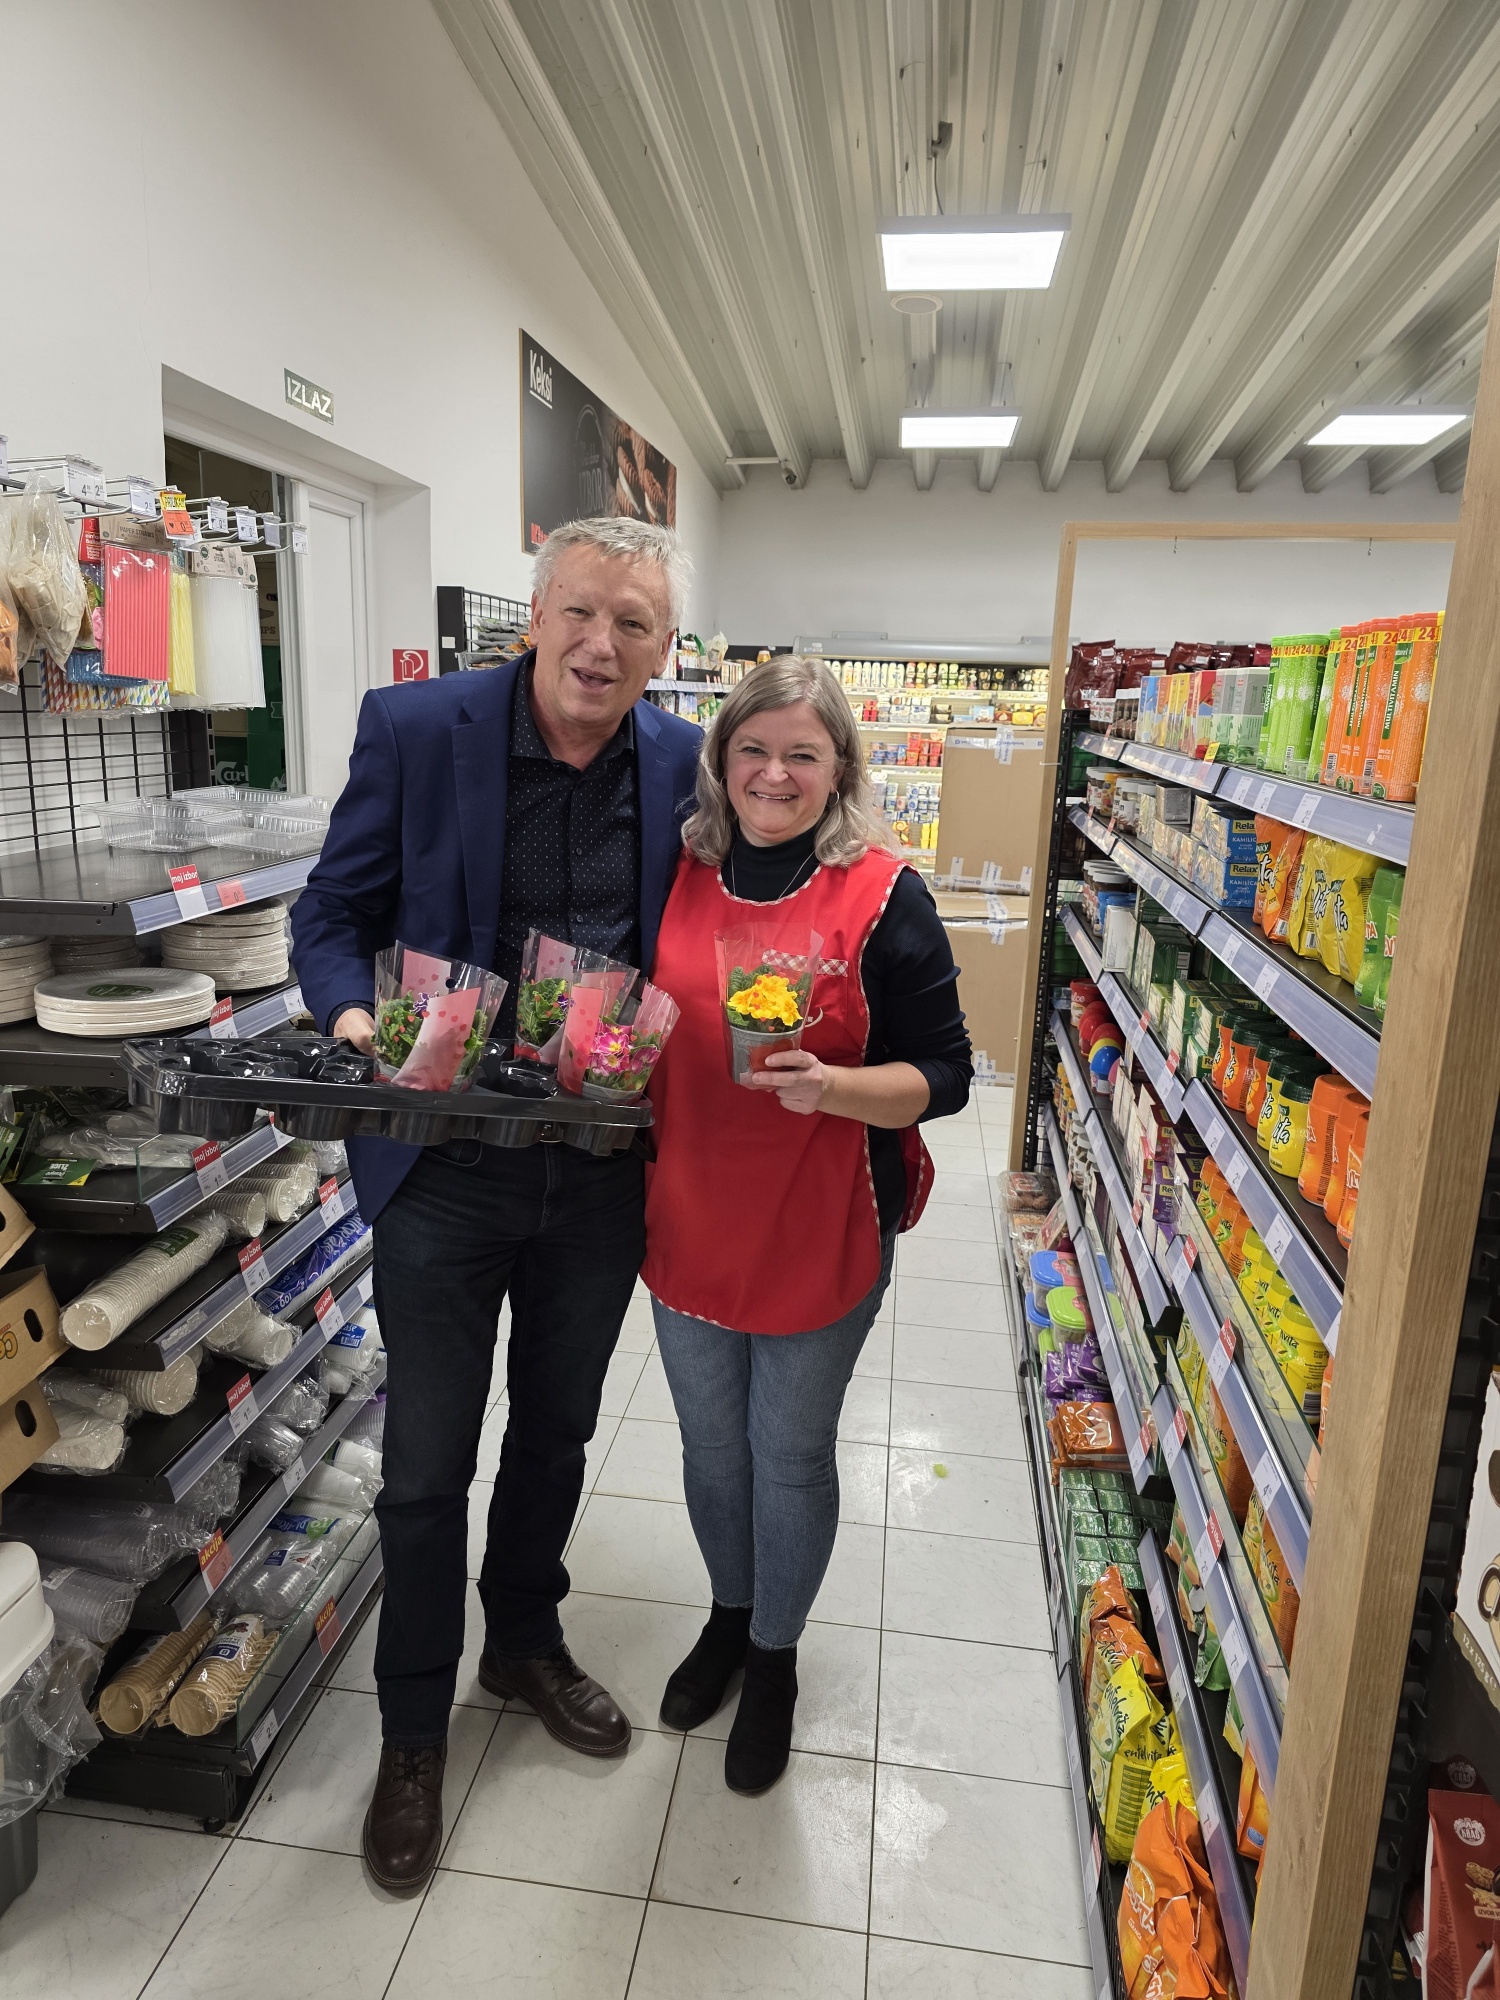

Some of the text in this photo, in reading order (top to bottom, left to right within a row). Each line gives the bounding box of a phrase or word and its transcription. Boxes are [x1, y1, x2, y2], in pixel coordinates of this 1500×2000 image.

[529, 349, 552, 402] Keksi
[287, 376, 332, 418] IZLAZ
[260, 626, 276, 634] IPS
[1383, 632, 1399, 645] 24
[1418, 627, 1436, 640] 24
[1344, 639, 1358, 651] 24
[1385, 670, 1399, 730] MULTIVITAMIN
[215, 761, 249, 785] Carl
[1235, 822, 1255, 830] Rela
[172, 871, 198, 884] moj izbor
[1232, 864, 1258, 873] Relax
[1260, 855, 1278, 888] ta
[1334, 894, 1348, 932] ta
[1365, 920, 1378, 940] TA
[1261, 1093, 1274, 1119] ita
[194, 1144, 219, 1164] moj izbor
[49, 1163, 70, 1171] ŽLICE
[279, 1294, 293, 1309] 100
[228, 1380, 251, 1404] moj izbor
[200, 1535, 223, 1565] akcija
[316, 1601, 335, 1630] akcija
[1463, 1633, 1470, 1649] 12
[1474, 1653, 1485, 1673] 125
